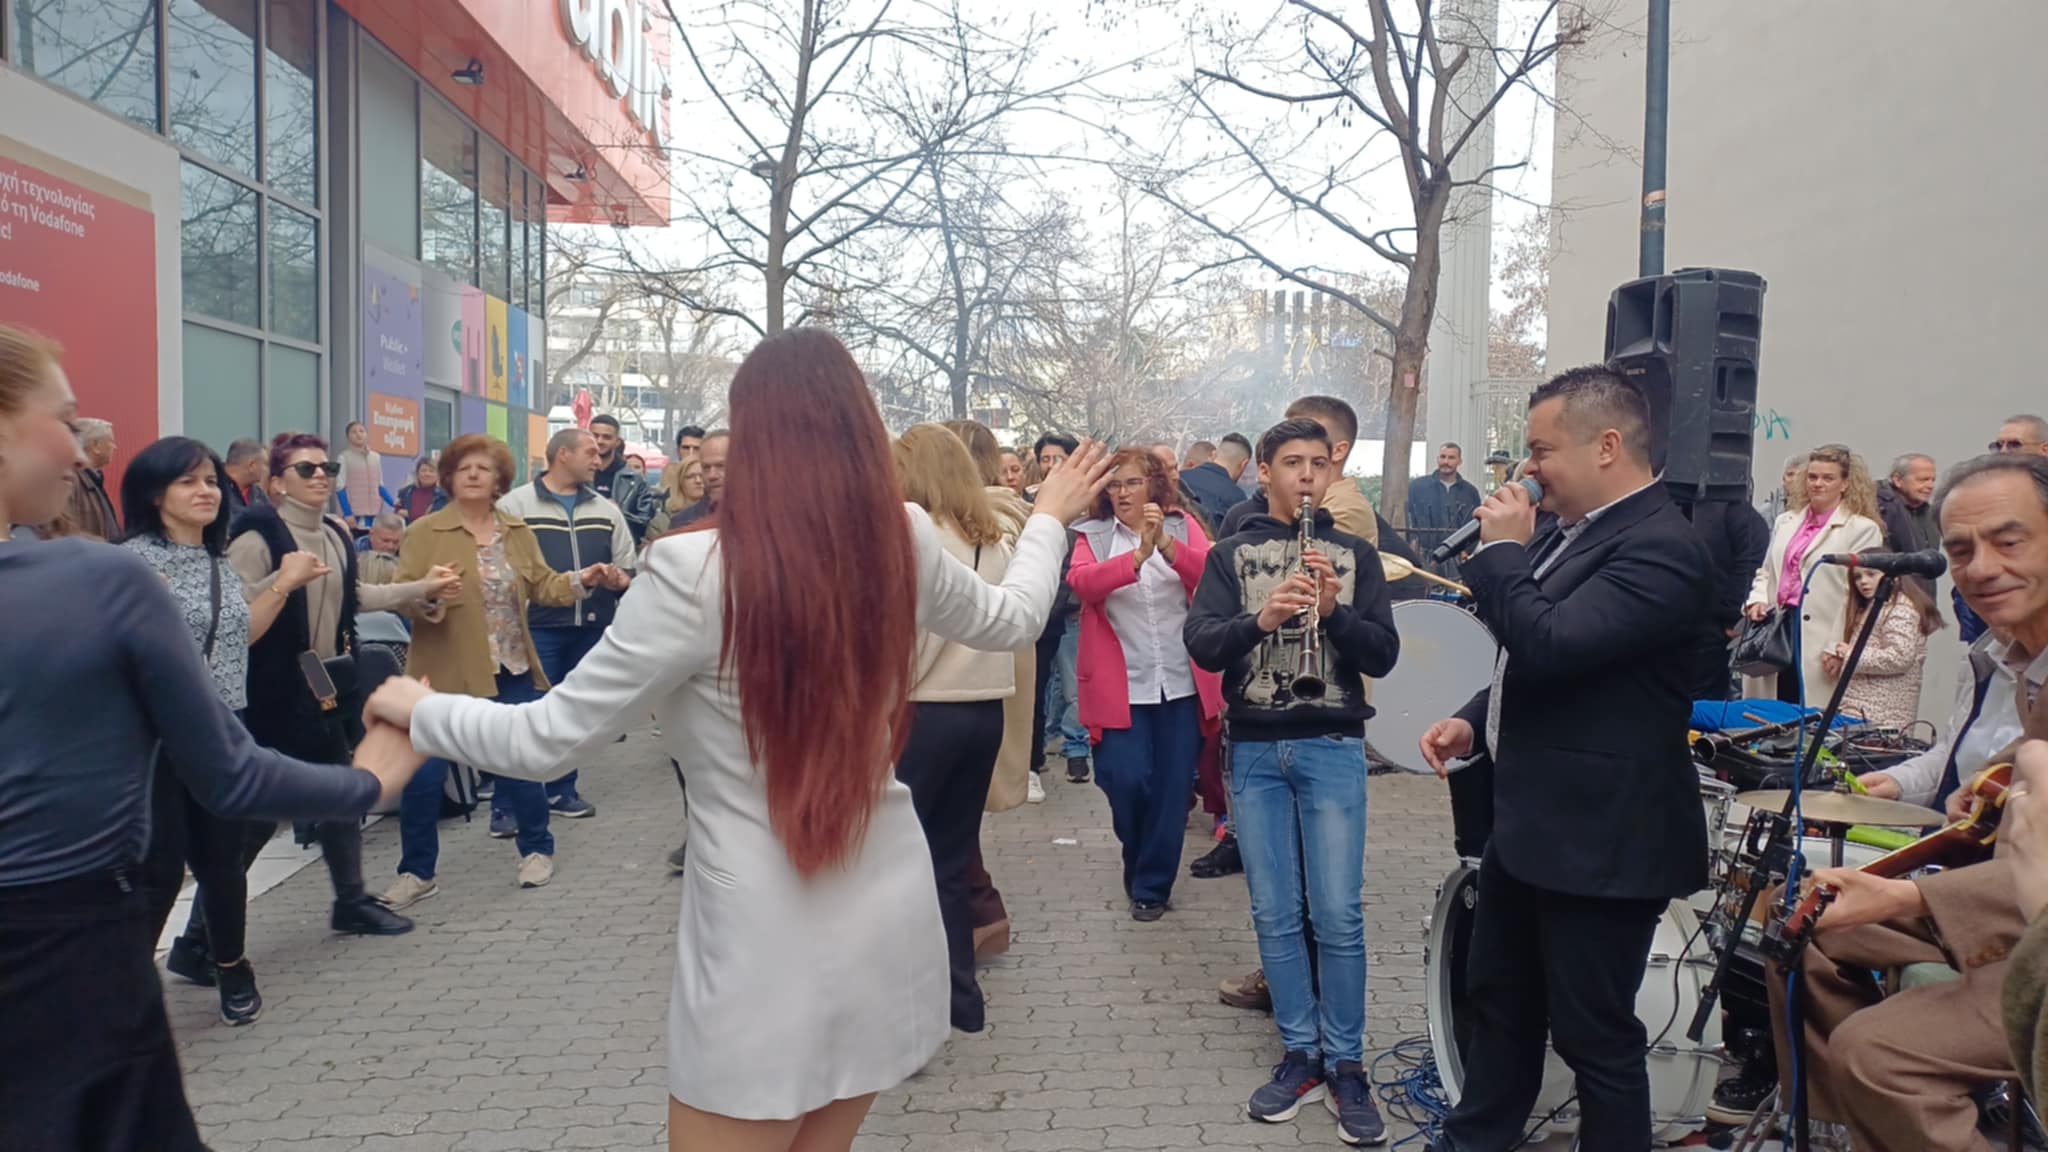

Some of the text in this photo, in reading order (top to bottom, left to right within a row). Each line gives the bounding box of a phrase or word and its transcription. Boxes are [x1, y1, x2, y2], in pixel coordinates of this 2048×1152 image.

[21, 179, 96, 221] τεχνολογίας
[11, 202, 28, 224] τη
[30, 204, 86, 238] Vodafone
